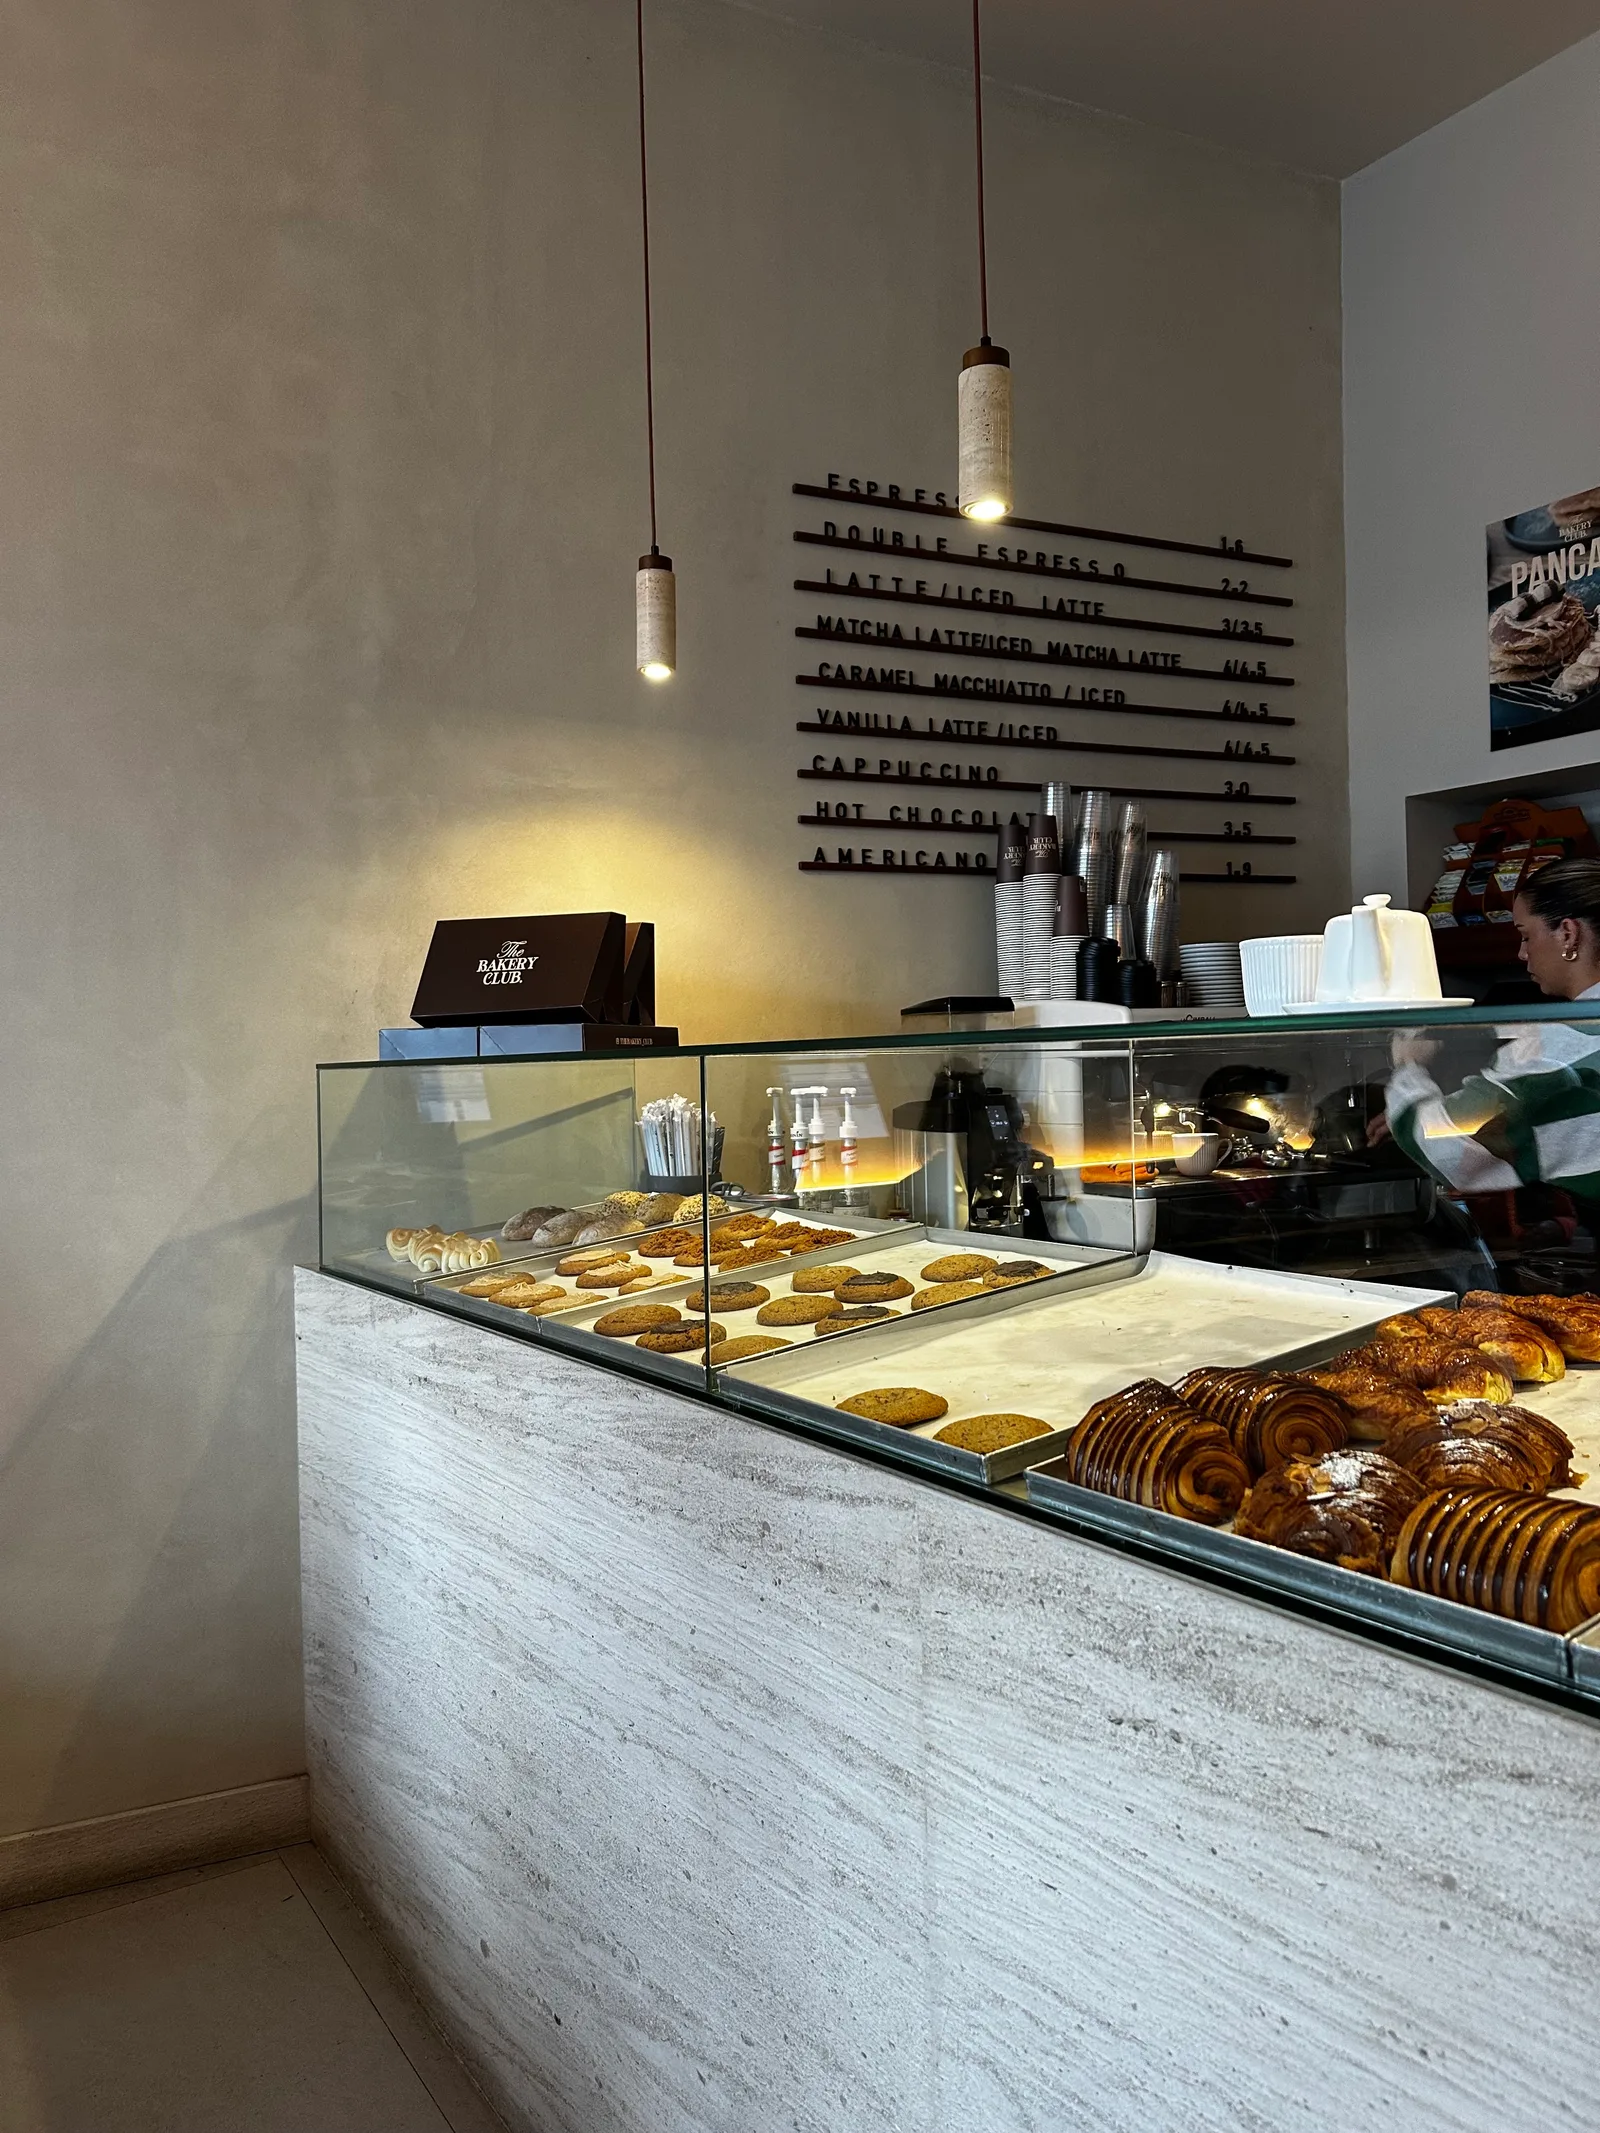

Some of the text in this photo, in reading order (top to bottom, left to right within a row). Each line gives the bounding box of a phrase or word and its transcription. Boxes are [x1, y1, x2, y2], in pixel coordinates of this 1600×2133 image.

[828, 473, 960, 508] ESPRES
[824, 521, 947, 553] DOUBLE
[1559, 520, 1592, 537] BAKERY
[1042, 596, 1104, 617] LATTE
[817, 615, 904, 640] MATCHA
[1047, 641, 1119, 663] MATCHA
[1128, 649, 1181, 668] LATTE
[818, 662, 919, 686] CARAMEL
[934, 673, 1051, 698] MACCHIATTO
[817, 708, 913, 731] VANILLA
[812, 755, 999, 782] CAPPUCCINO
[816, 801, 864, 820] HOT
[889, 805, 1036, 826] CHOCOLAT
[813, 847, 987, 868] AMERICANO
[496, 940, 528, 958] The
[476, 957, 539, 973] BAKERY
[483, 971, 523, 985] CLUB.
